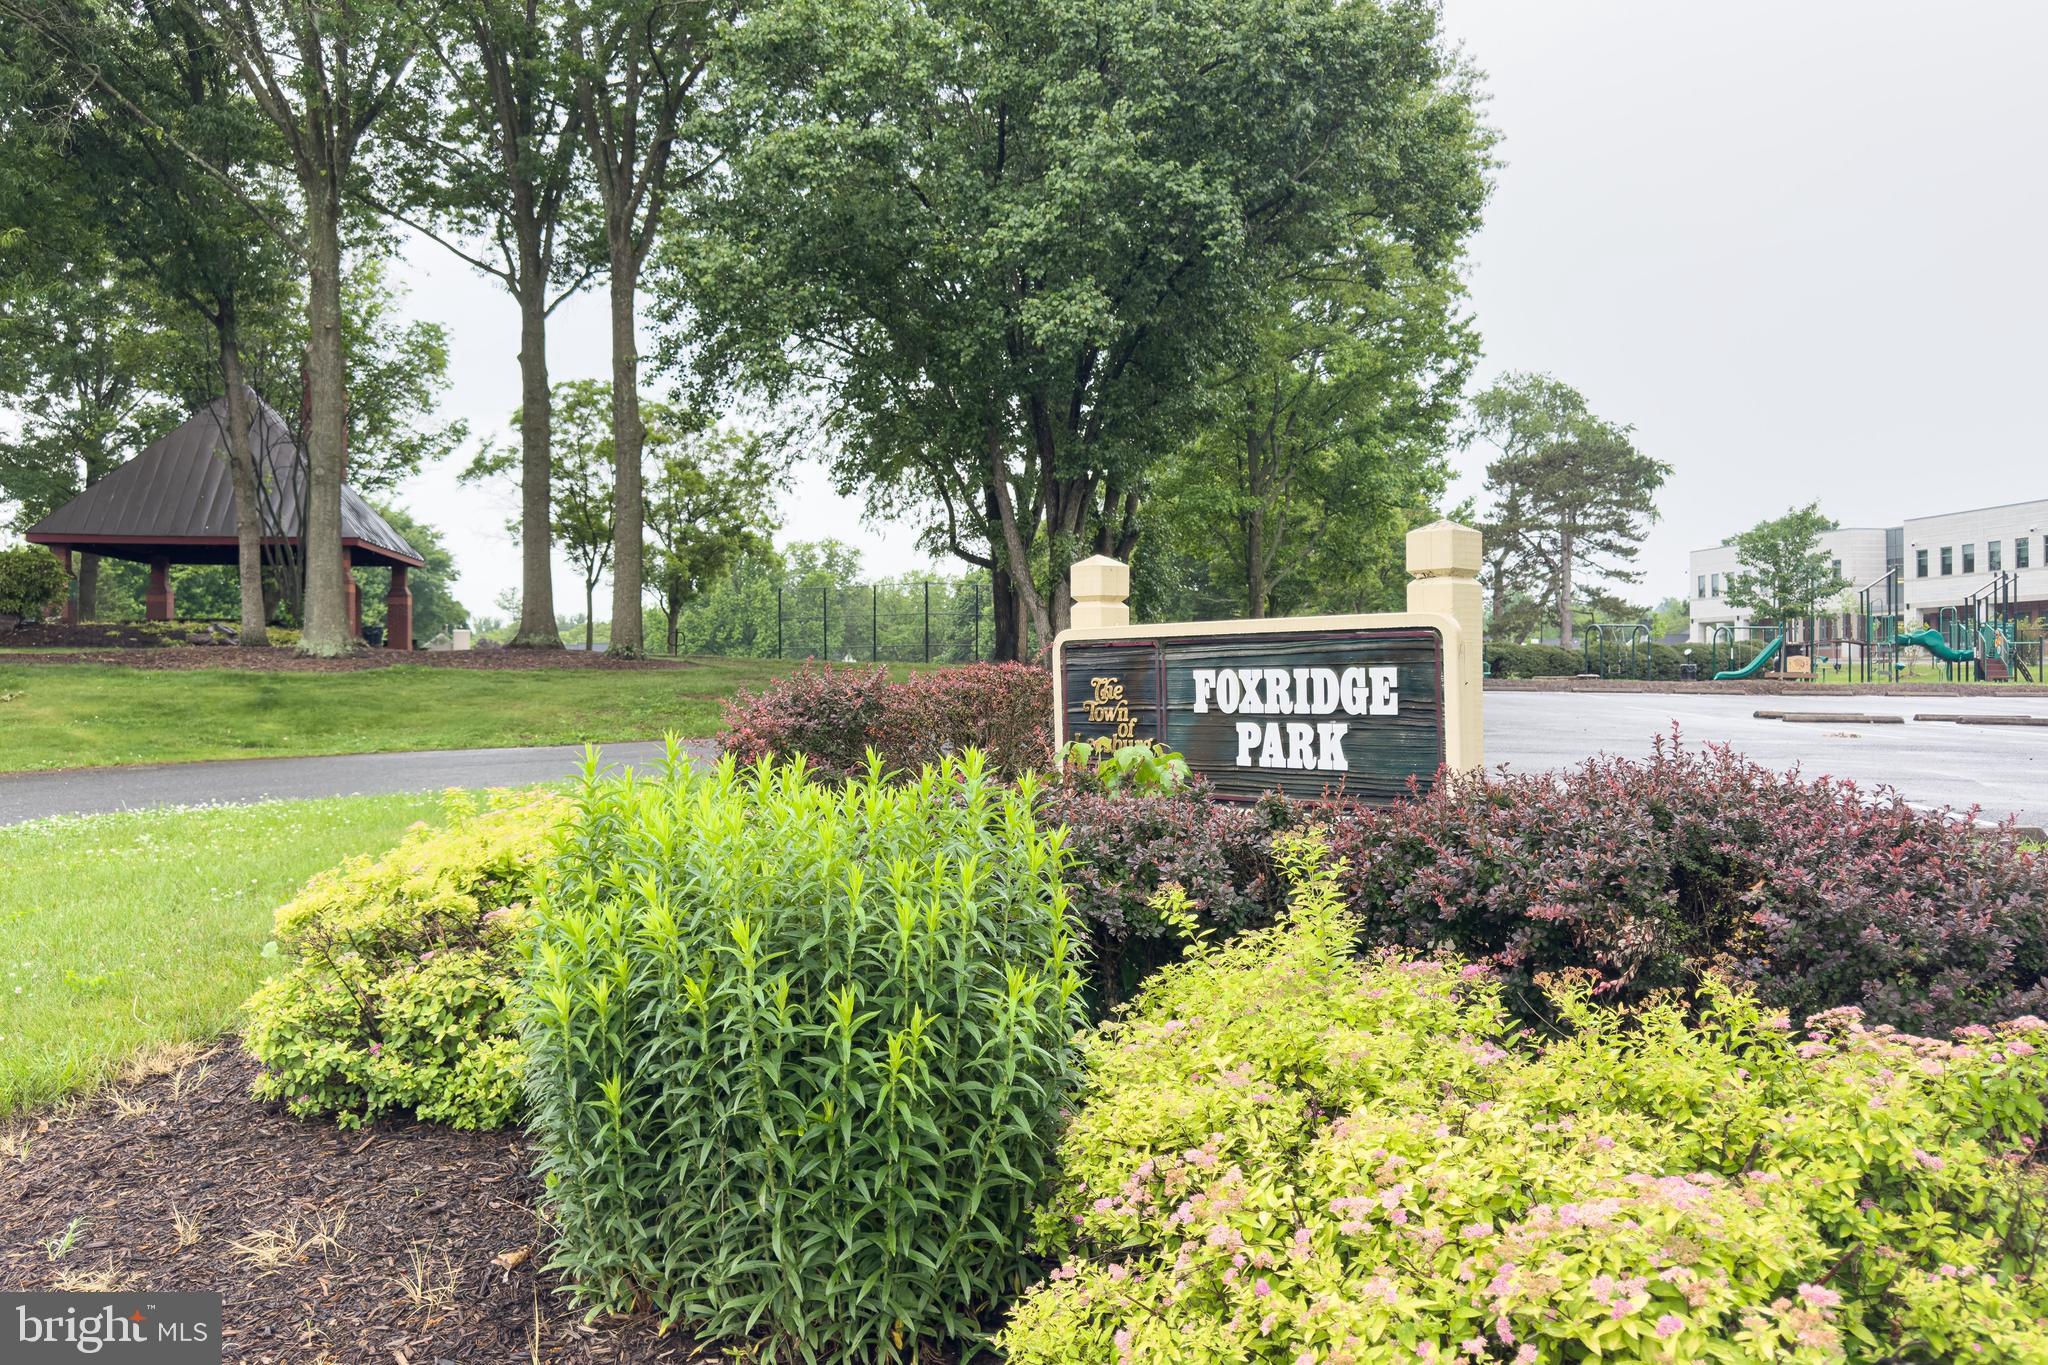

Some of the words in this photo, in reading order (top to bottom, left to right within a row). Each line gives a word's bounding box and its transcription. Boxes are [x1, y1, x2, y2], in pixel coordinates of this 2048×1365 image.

[1091, 677, 1124, 704] The
[1192, 667, 1399, 715] FOXRIDGE
[1083, 699, 1129, 722] Town
[1117, 717, 1137, 738] of
[1236, 721, 1349, 771] PARK
